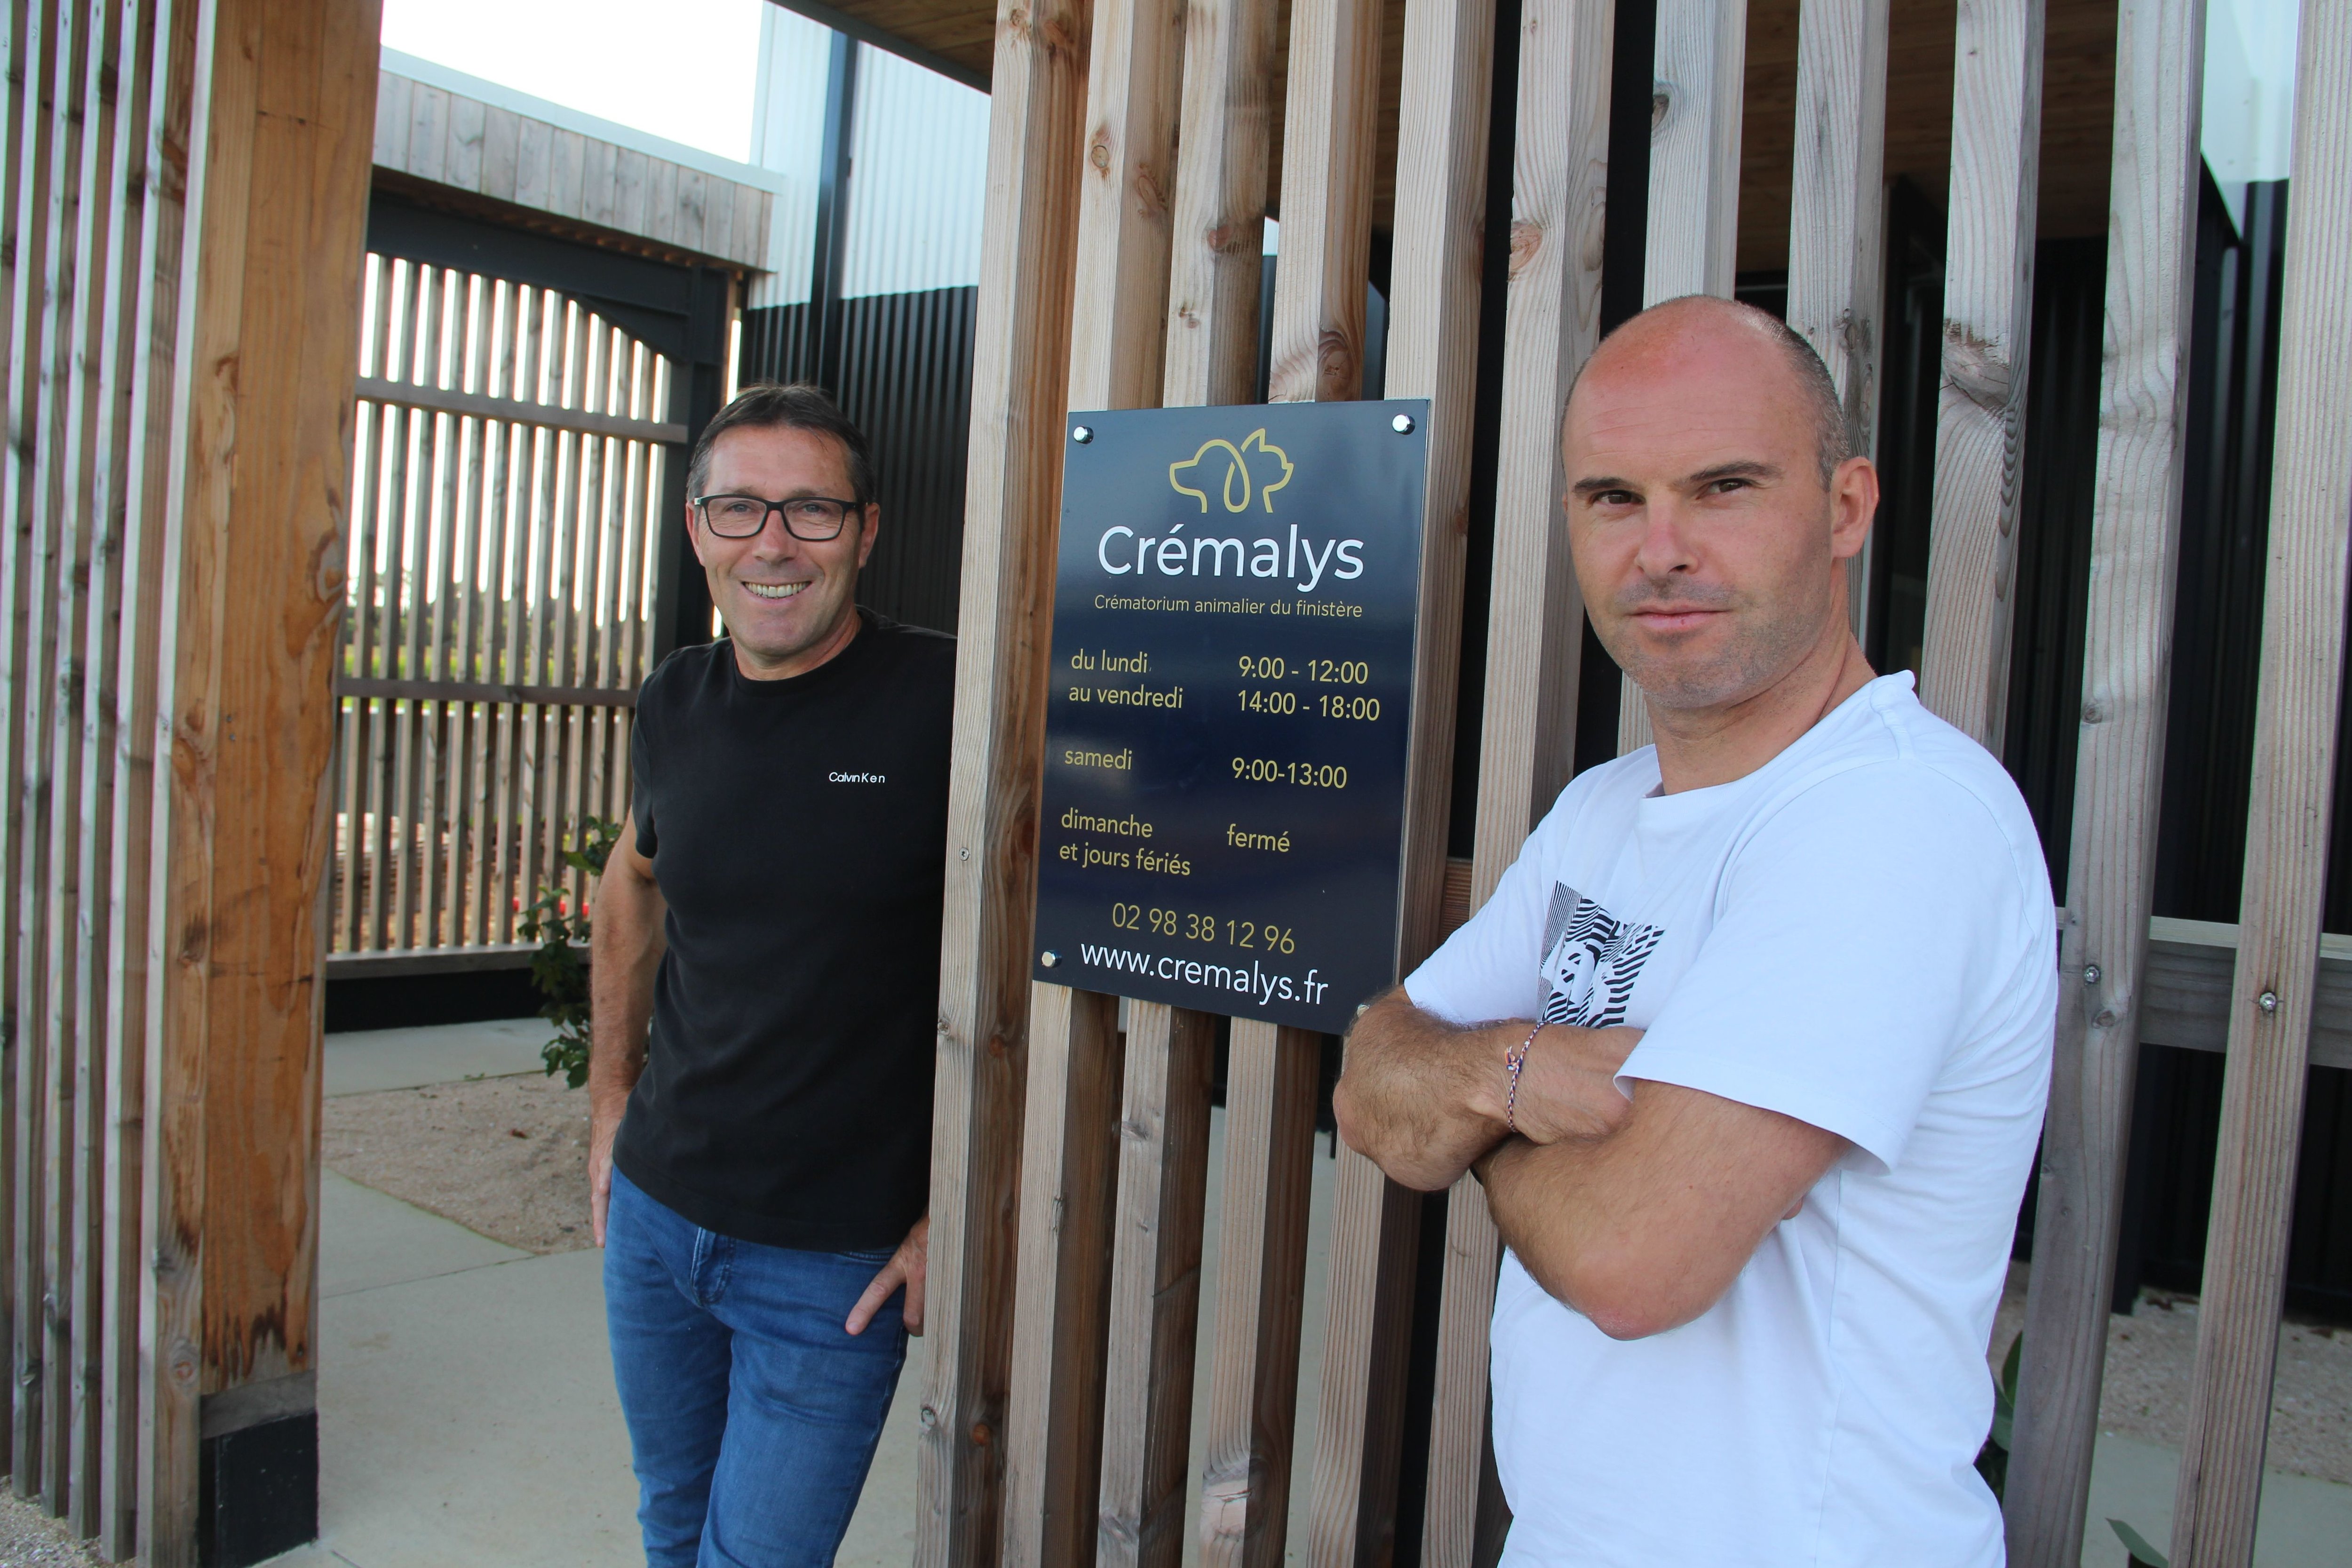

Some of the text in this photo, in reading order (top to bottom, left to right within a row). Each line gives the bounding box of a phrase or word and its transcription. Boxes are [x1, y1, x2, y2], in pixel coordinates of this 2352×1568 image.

[1098, 524, 1364, 592] Crémalys
[1095, 594, 1362, 618] Crématorium animalier du finistère
[1071, 648, 1148, 673] du lundi
[1239, 656, 1285, 679] 9:00
[1308, 660, 1368, 684] 12:00
[1069, 684, 1183, 708] au vendredi
[1238, 690, 1295, 715] 14:00
[1319, 695, 1380, 721] 18:00
[1065, 748, 1132, 770] samedi
[1232, 757, 1347, 788] 9:00-13:00
[1061, 807, 1152, 838] dimanche
[1227, 823, 1290, 852] fermé
[1059, 842, 1190, 876] et jours fériés
[1112, 903, 1295, 954] 02 98 38 12 96
[1081, 943, 1328, 1006] www.cremalys.fr
